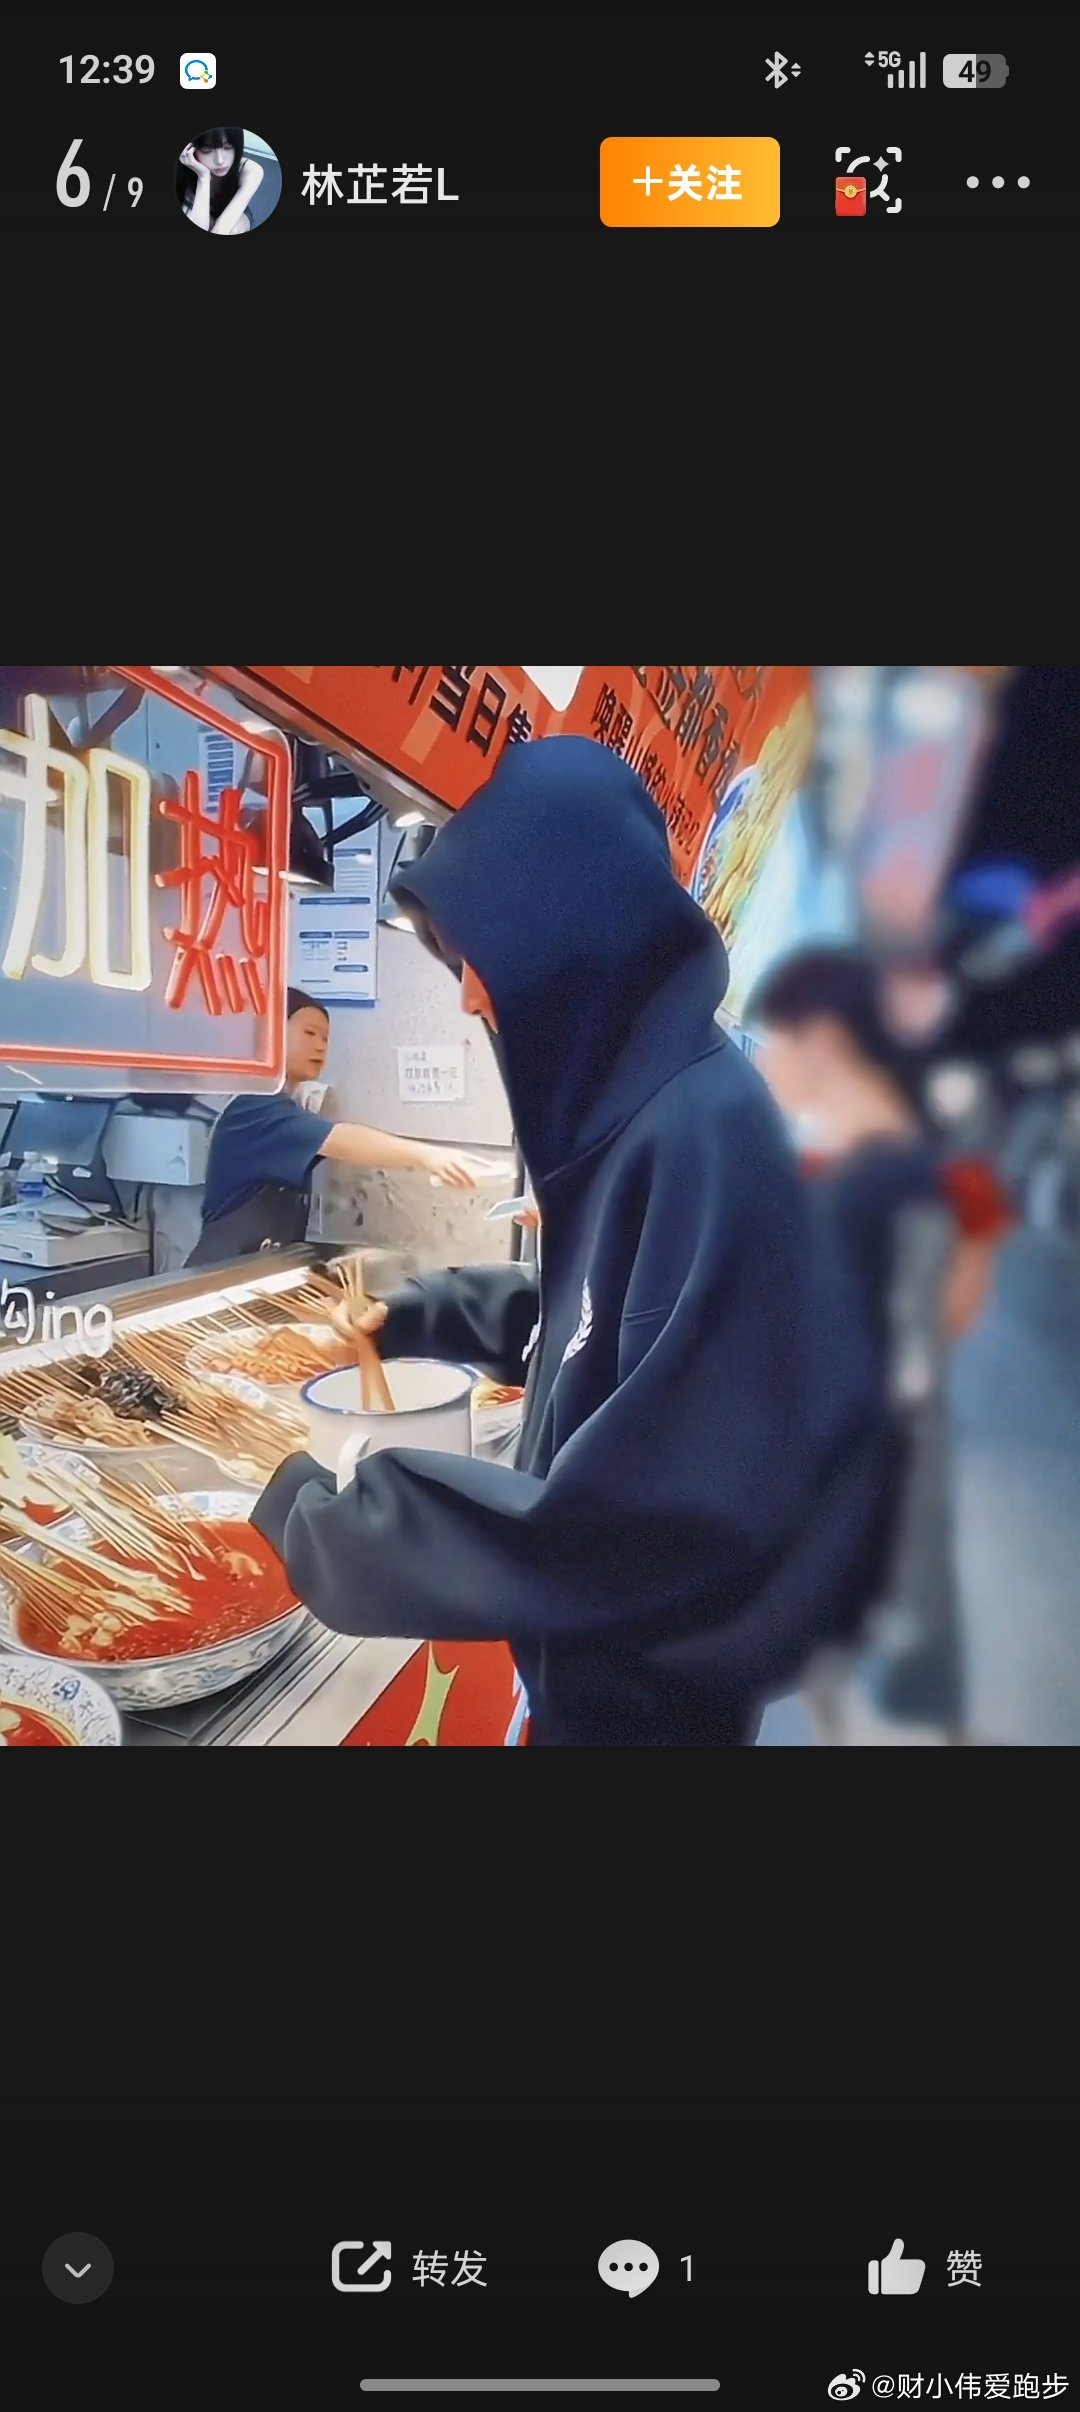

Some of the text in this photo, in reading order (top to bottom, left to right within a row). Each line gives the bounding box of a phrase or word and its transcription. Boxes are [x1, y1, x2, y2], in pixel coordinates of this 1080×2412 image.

[60, 55, 154, 84] 12:39
[878, 50, 902, 68] 5G
[958, 60, 992, 83] 49
[300, 162, 460, 206] 林芷若L
[412, 2249, 488, 2288] 转发
[680, 2254, 695, 2282] 1
[946, 2249, 983, 2288] 赞
